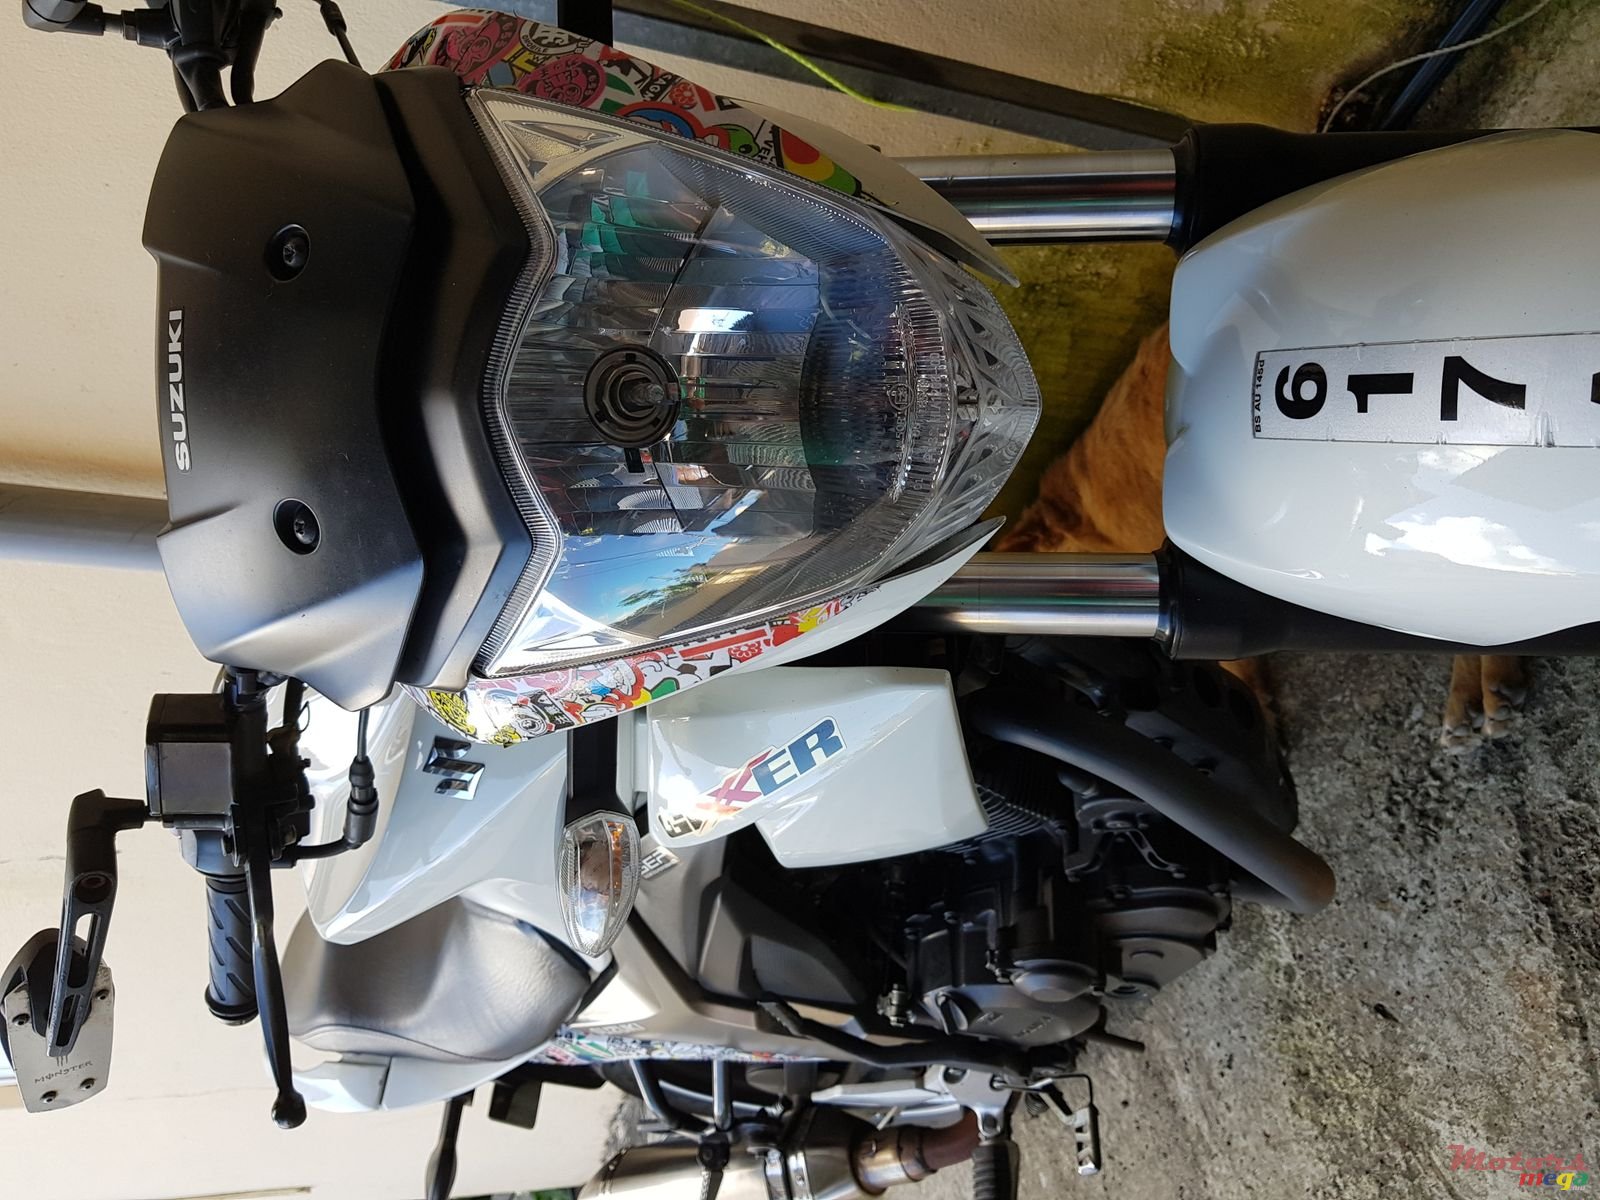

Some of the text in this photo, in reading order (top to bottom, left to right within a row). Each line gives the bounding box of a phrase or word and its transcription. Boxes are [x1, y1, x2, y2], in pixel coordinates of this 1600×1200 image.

[168, 309, 190, 471] SUZUKI
[1254, 392, 1262, 412] AU
[1254, 415, 1262, 433] BS
[34, 1060, 93, 1084] MONSTER
